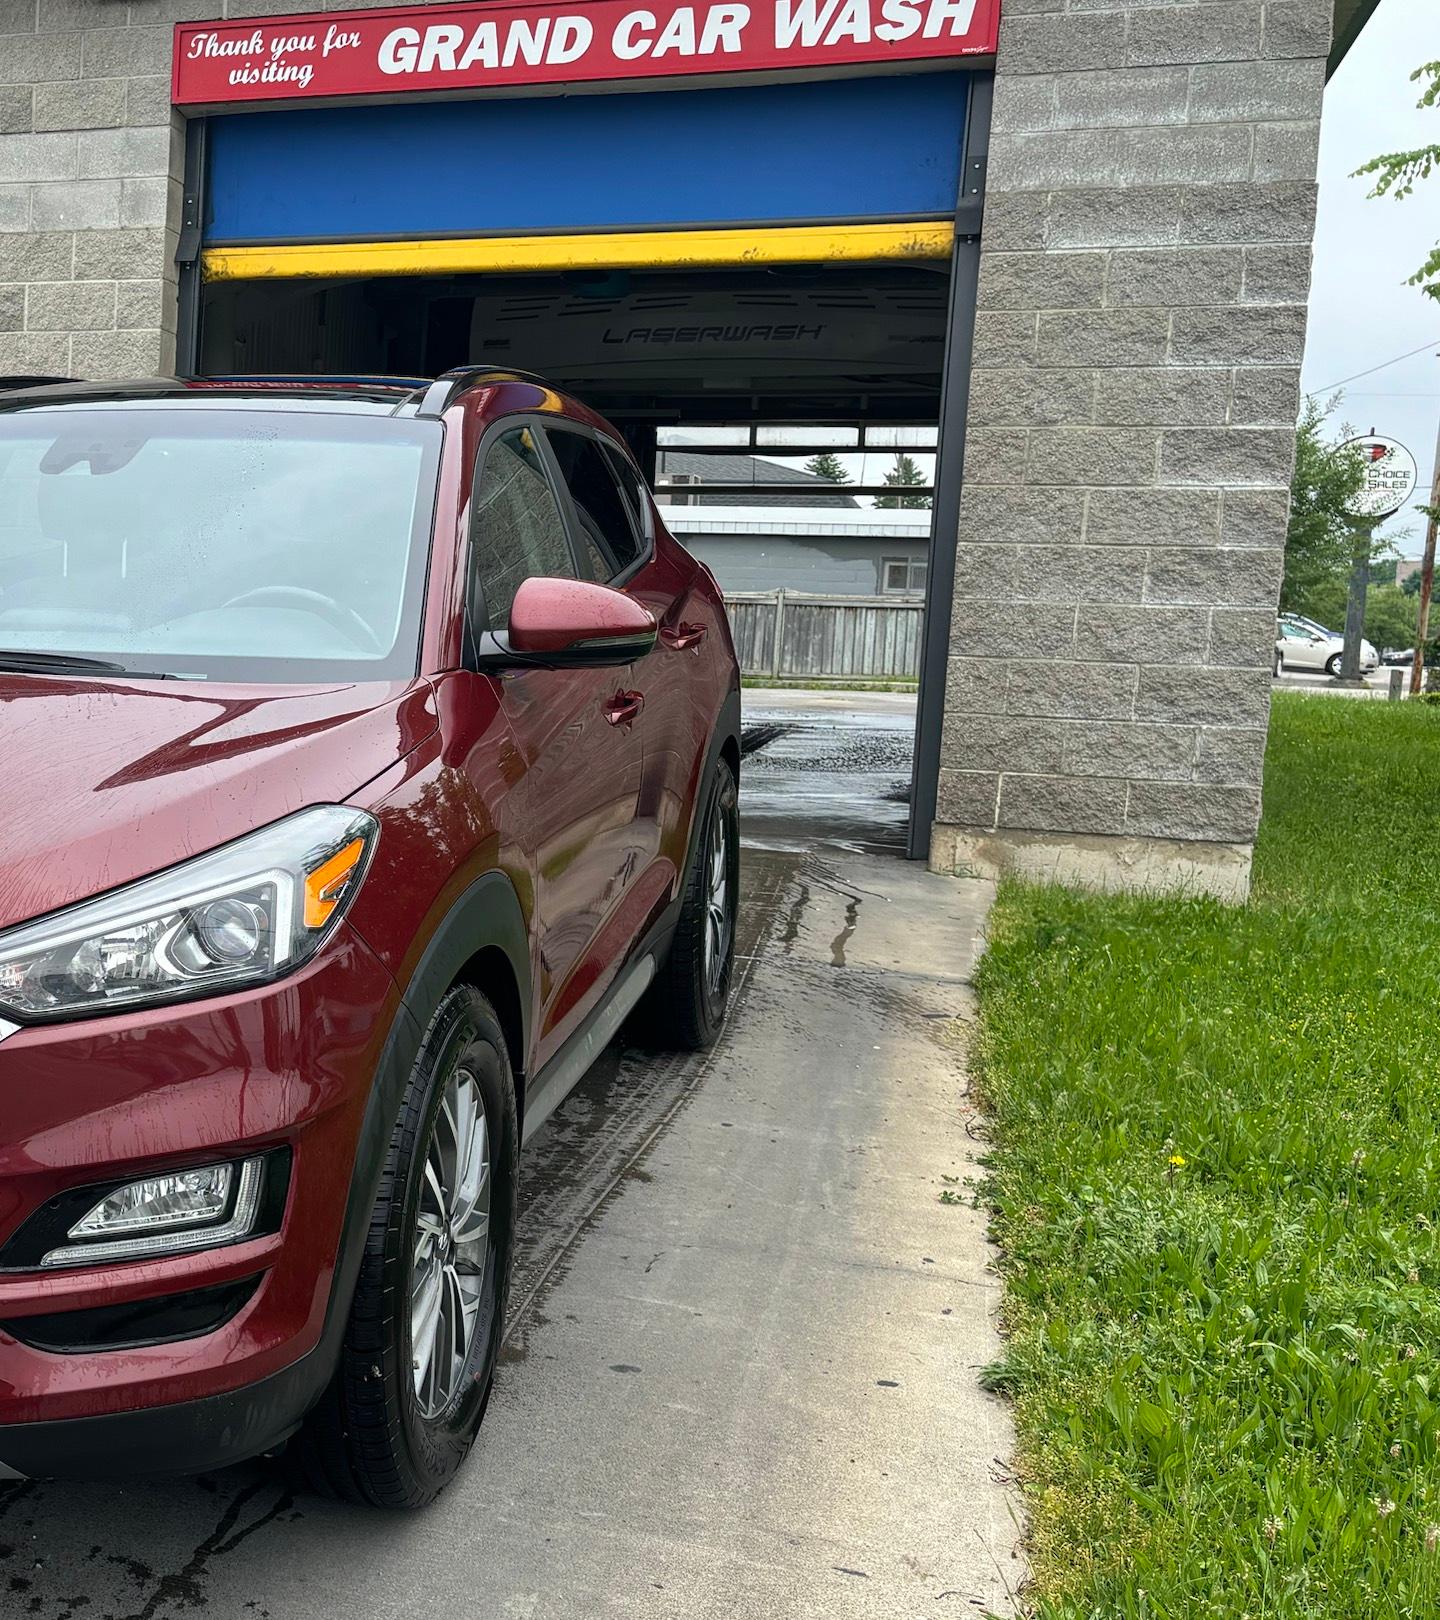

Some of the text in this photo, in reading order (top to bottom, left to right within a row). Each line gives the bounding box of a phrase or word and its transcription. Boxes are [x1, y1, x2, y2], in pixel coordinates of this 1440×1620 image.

[186, 24, 361, 62] Thank you for
[376, 0, 978, 75] GRAND CAR WASH
[228, 60, 315, 89] visiting
[602, 324, 822, 345] LASERWASH
[1368, 469, 1411, 479] CHOICE
[1368, 479, 1408, 489] SALES
